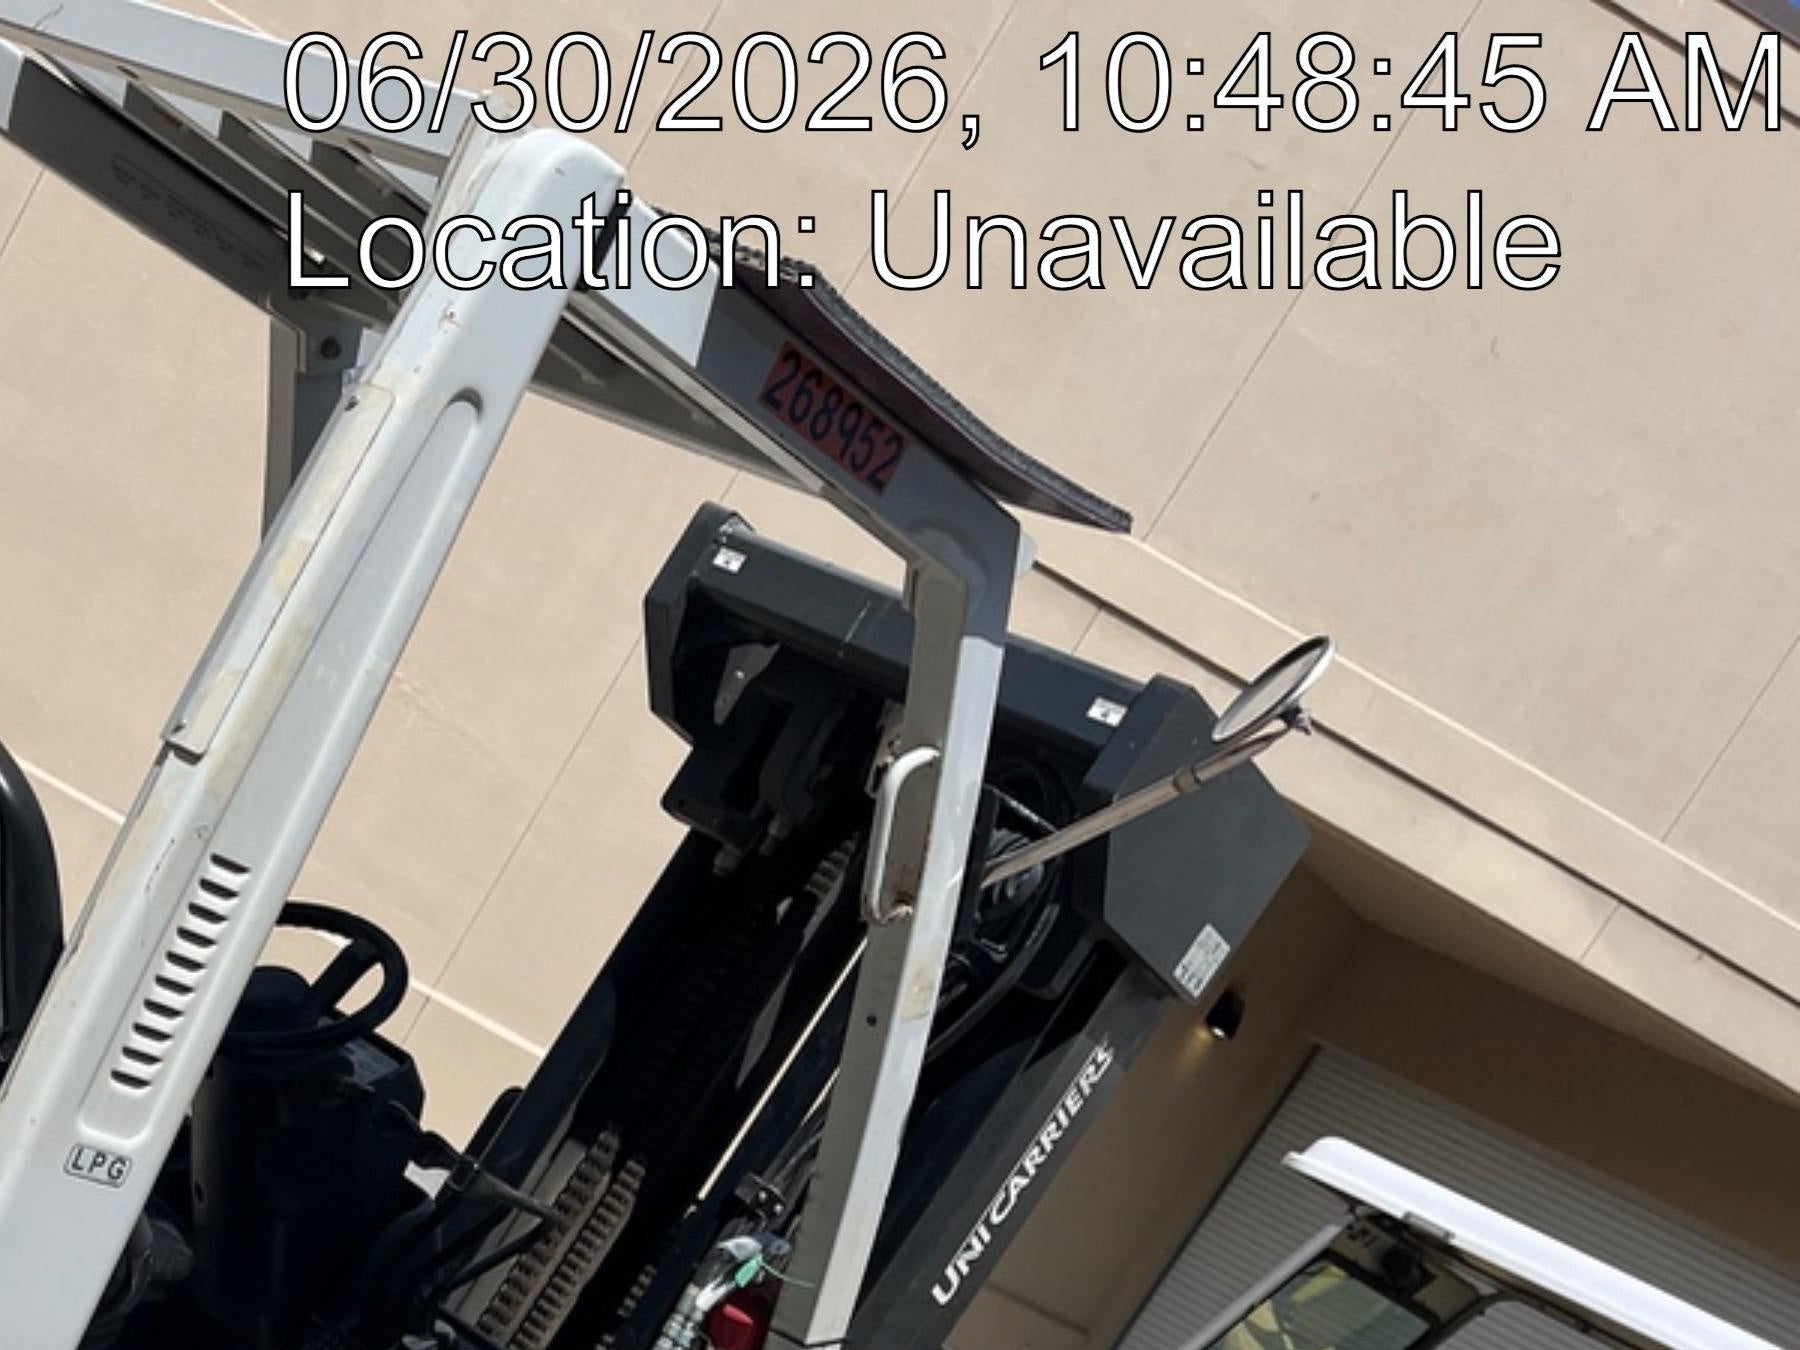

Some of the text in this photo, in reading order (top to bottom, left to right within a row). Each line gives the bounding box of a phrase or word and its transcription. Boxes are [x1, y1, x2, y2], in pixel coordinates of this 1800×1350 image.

[759, 349, 906, 492] 268952
[71, 1145, 127, 1180] LPG
[932, 1040, 1114, 1306] UNICARRIERS
